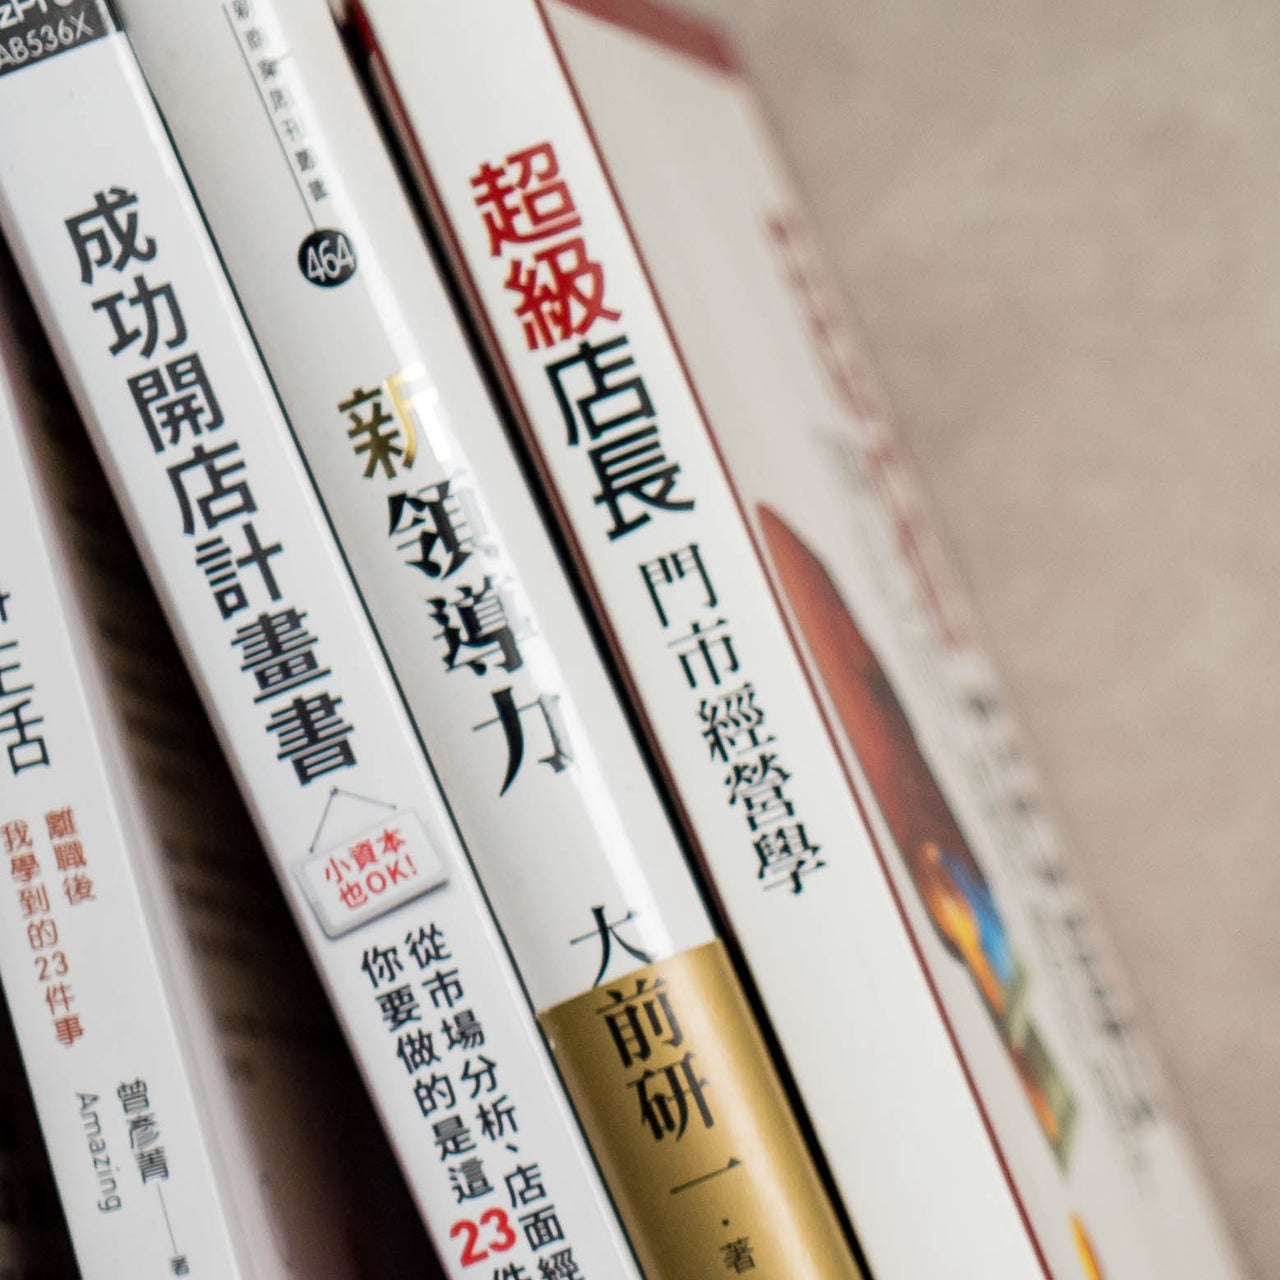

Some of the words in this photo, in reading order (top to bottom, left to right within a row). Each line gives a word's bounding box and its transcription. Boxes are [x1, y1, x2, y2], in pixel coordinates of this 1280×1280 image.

[306, 235, 356, 283] 464
[469, 141, 695, 542] 超級店長
[63, 185, 358, 787] 成功開店計畫書
[337, 363, 574, 797] 新領導力
[637, 542, 828, 894] 門市經營學
[44, 805, 97, 907] 離職後
[325, 827, 406, 883] 小資本
[340, 853, 418, 910] 也OK!
[75, 1091, 123, 1214] Amazing
[570, 904, 743, 1196] 大前研一
